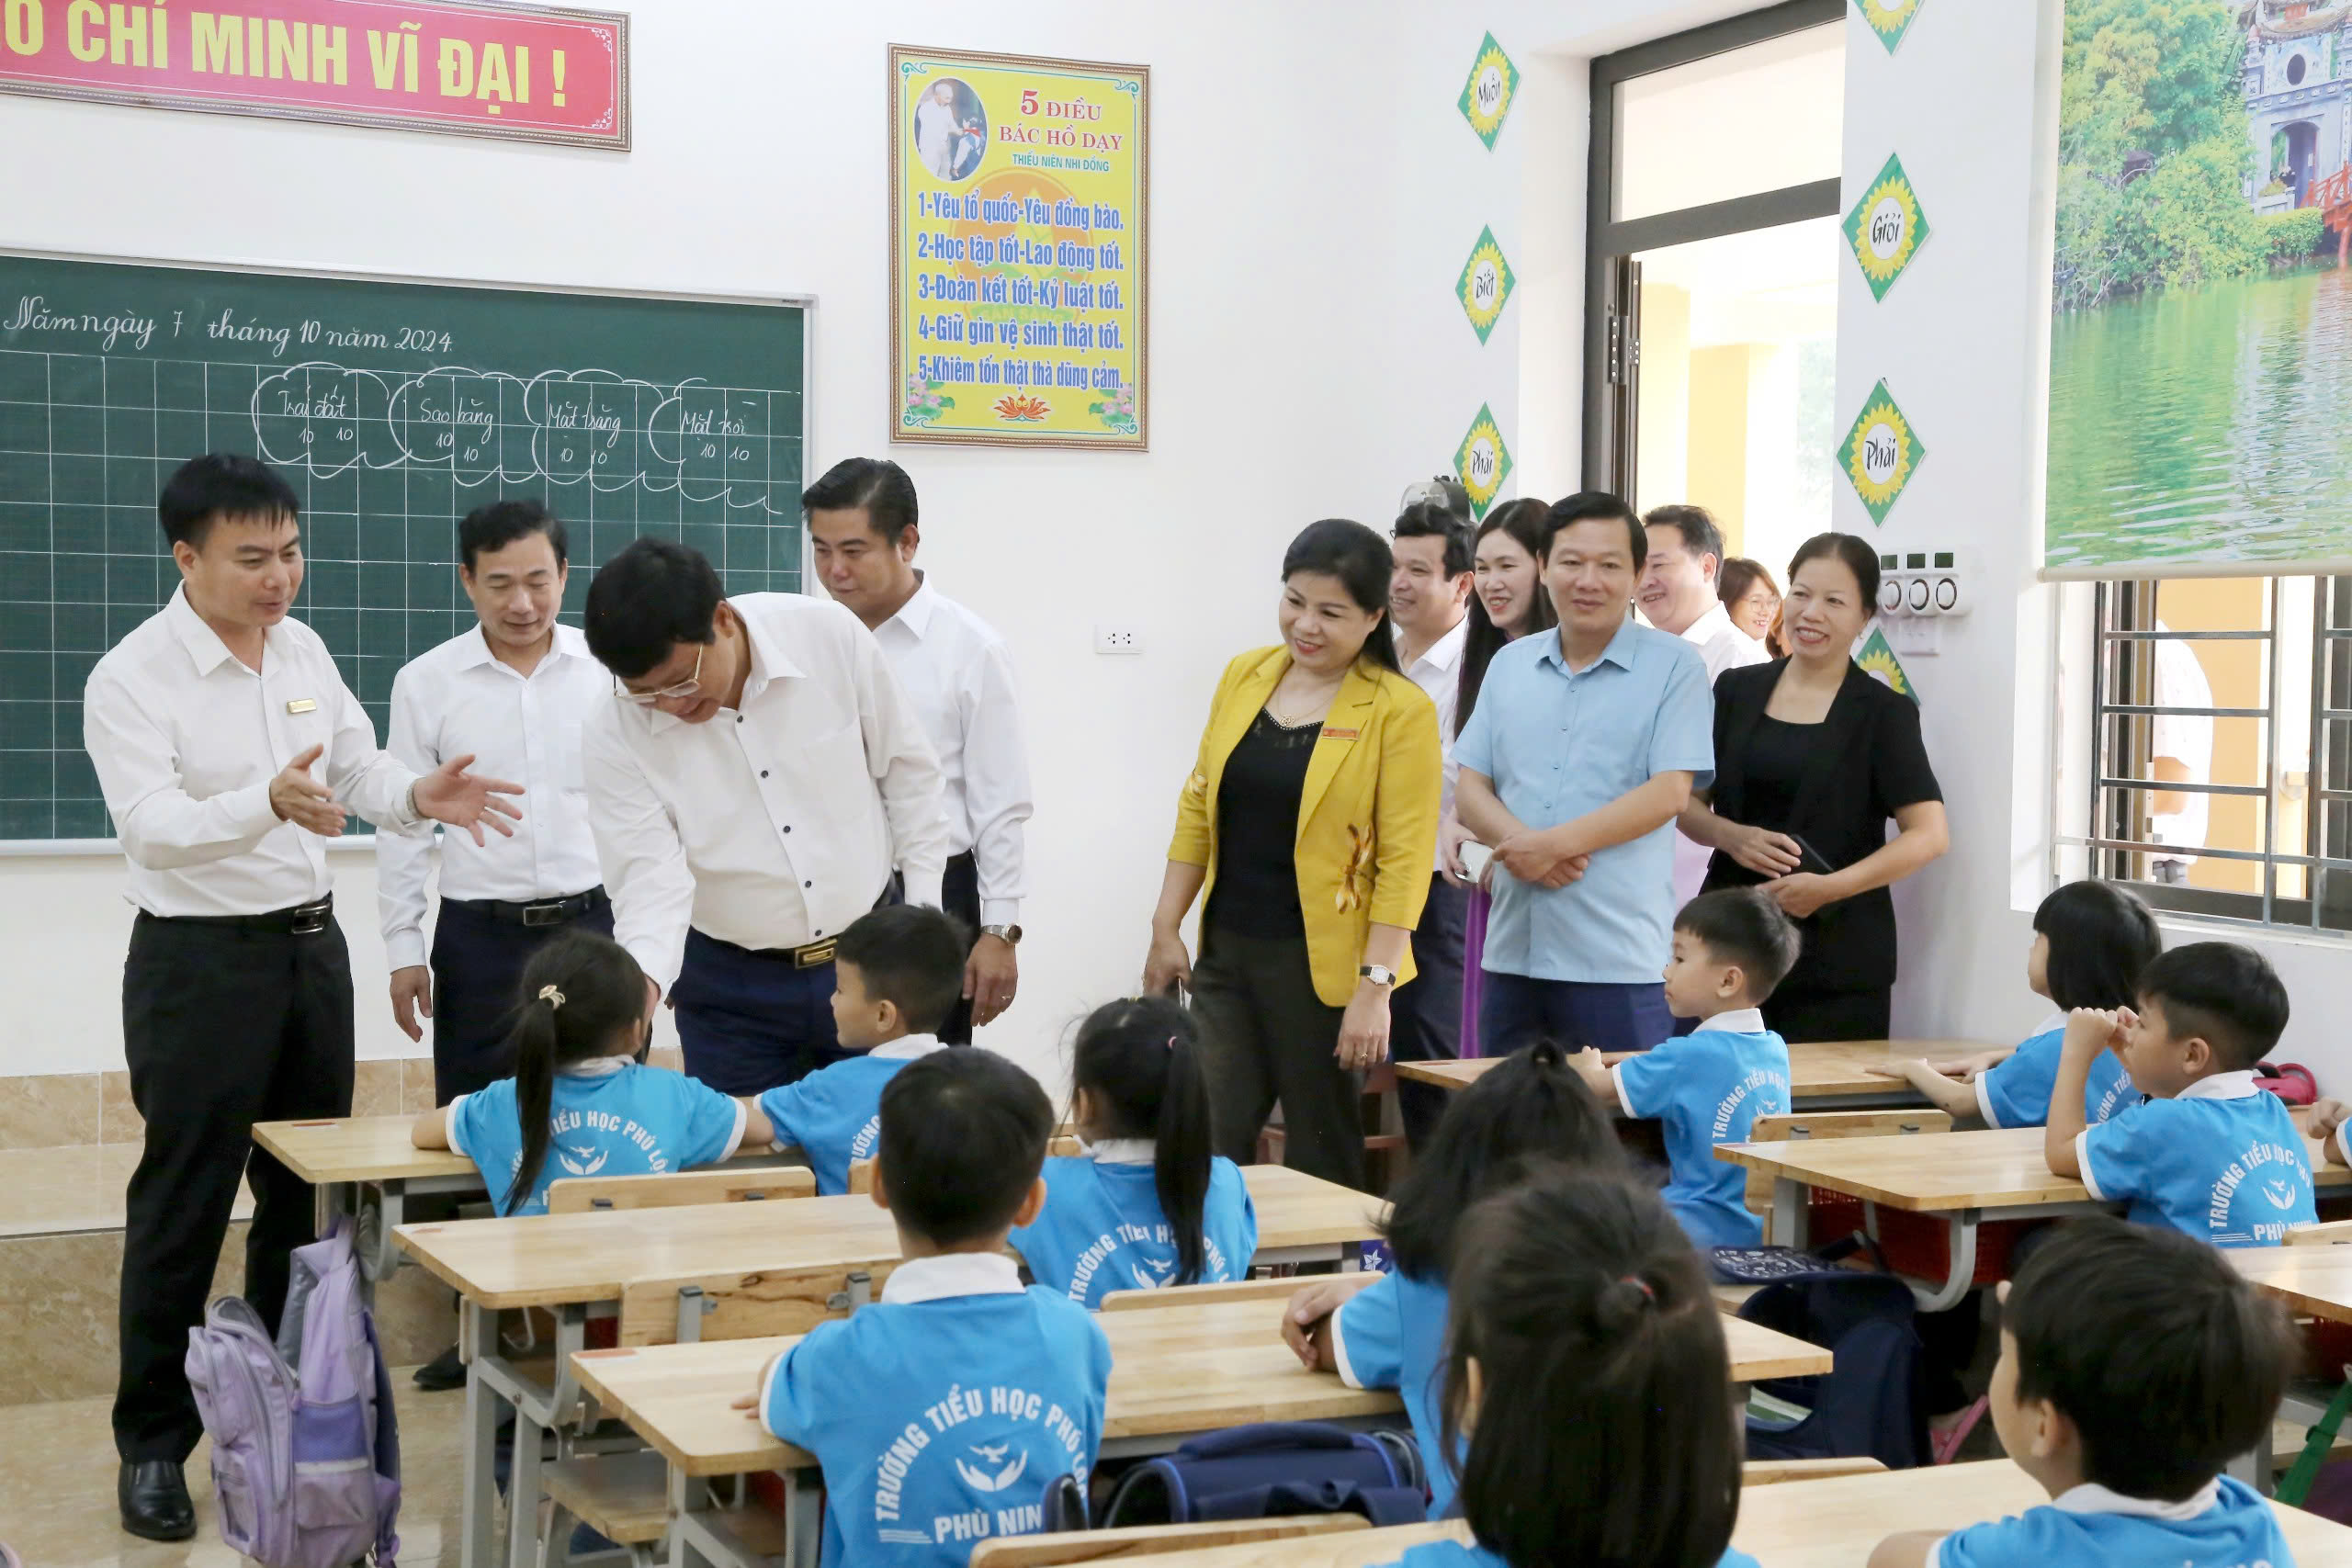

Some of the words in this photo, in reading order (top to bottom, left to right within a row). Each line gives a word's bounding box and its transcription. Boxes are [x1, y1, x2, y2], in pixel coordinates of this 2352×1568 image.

[67, 0, 168, 68] CHÍ
[191, 13, 347, 85] MINH
[368, 21, 422, 93] VĨ
[437, 39, 529, 114] ĐẠI
[551, 50, 566, 107] !
[1021, 90, 1038, 115] 5
[1046, 96, 1102, 120] ĐIỀU
[999, 122, 1040, 143] BÁC
[1046, 124, 1076, 147] HỒ
[1081, 133, 1123, 153] DẠY
[1012, 150, 1039, 166] THIẾU
[1041, 153, 1063, 168] NIÊN
[1065, 155, 1080, 169] NHI
[919, 192, 960, 220] 1-Yêu
[965, 189, 979, 220] tổ
[983, 194, 1050, 224] quốc-Yêu
[1056, 197, 1090, 231] đồng
[1094, 203, 1125, 230] bào.
[919, 232, 965, 265] 2-Học
[969, 235, 994, 267] tập
[999, 234, 1053, 265] tốt-Lao
[1057, 241, 1095, 272] động
[1100, 241, 1124, 270] tốt.
[919, 274, 977, 301] 3-Đoàn
[982, 274, 1007, 304] kết
[1012, 276, 1059, 309] tốt-Kỷ
[1064, 281, 1094, 313] luật
[1099, 281, 1124, 310] tốt.
[77, 310, 155, 351] ngày
[172, 310, 184, 337] 7
[207, 308, 290, 356] tháng
[299, 319, 321, 344] 10
[324, 326, 389, 348] năm
[919, 313, 964, 341] 4-Giữ
[968, 316, 994, 344] gìn
[999, 319, 1018, 350] vệ
[1023, 321, 1057, 346] sinh
[1062, 322, 1093, 353] thật
[1099, 320, 1124, 349] tốt.
[919, 355, 975, 383] 5-Khiêm
[978, 355, 1000, 384] tốn
[1003, 359, 1029, 390] thật
[1033, 359, 1053, 387] thà
[1057, 362, 1088, 389] dũng
[1091, 360, 1123, 389] cảm.
[299, 427, 314, 444] 10
[336, 426, 354, 441] 10
[420, 398, 450, 422] Sao
[457, 397, 493, 445] băng
[435, 432, 453, 448] 10
[464, 446, 478, 462] 10
[560, 447, 573, 462] 10
[700, 443, 716, 458] 10
[729, 446, 749, 460] 10
[1865, 437, 1896, 471] Phải
[587, 1110, 621, 1133] HỌC
[622, 1119, 656, 1152] PHÚ
[1713, 1085, 1746, 1139] TRƯỜNG
[2209, 1162, 2246, 1229] TRƯỜNG
[2241, 1140, 2272, 1170] TIỂU
[1069, 1234, 1118, 1302] TRƯỜNG
[876, 1423, 931, 1521] TRƯỜNG
[924, 1383, 984, 1433] TIỂU
[991, 1387, 1042, 1422] HỌC
[1044, 1404, 1083, 1453] PHÚ
[934, 1508, 989, 1544] PHÙ
